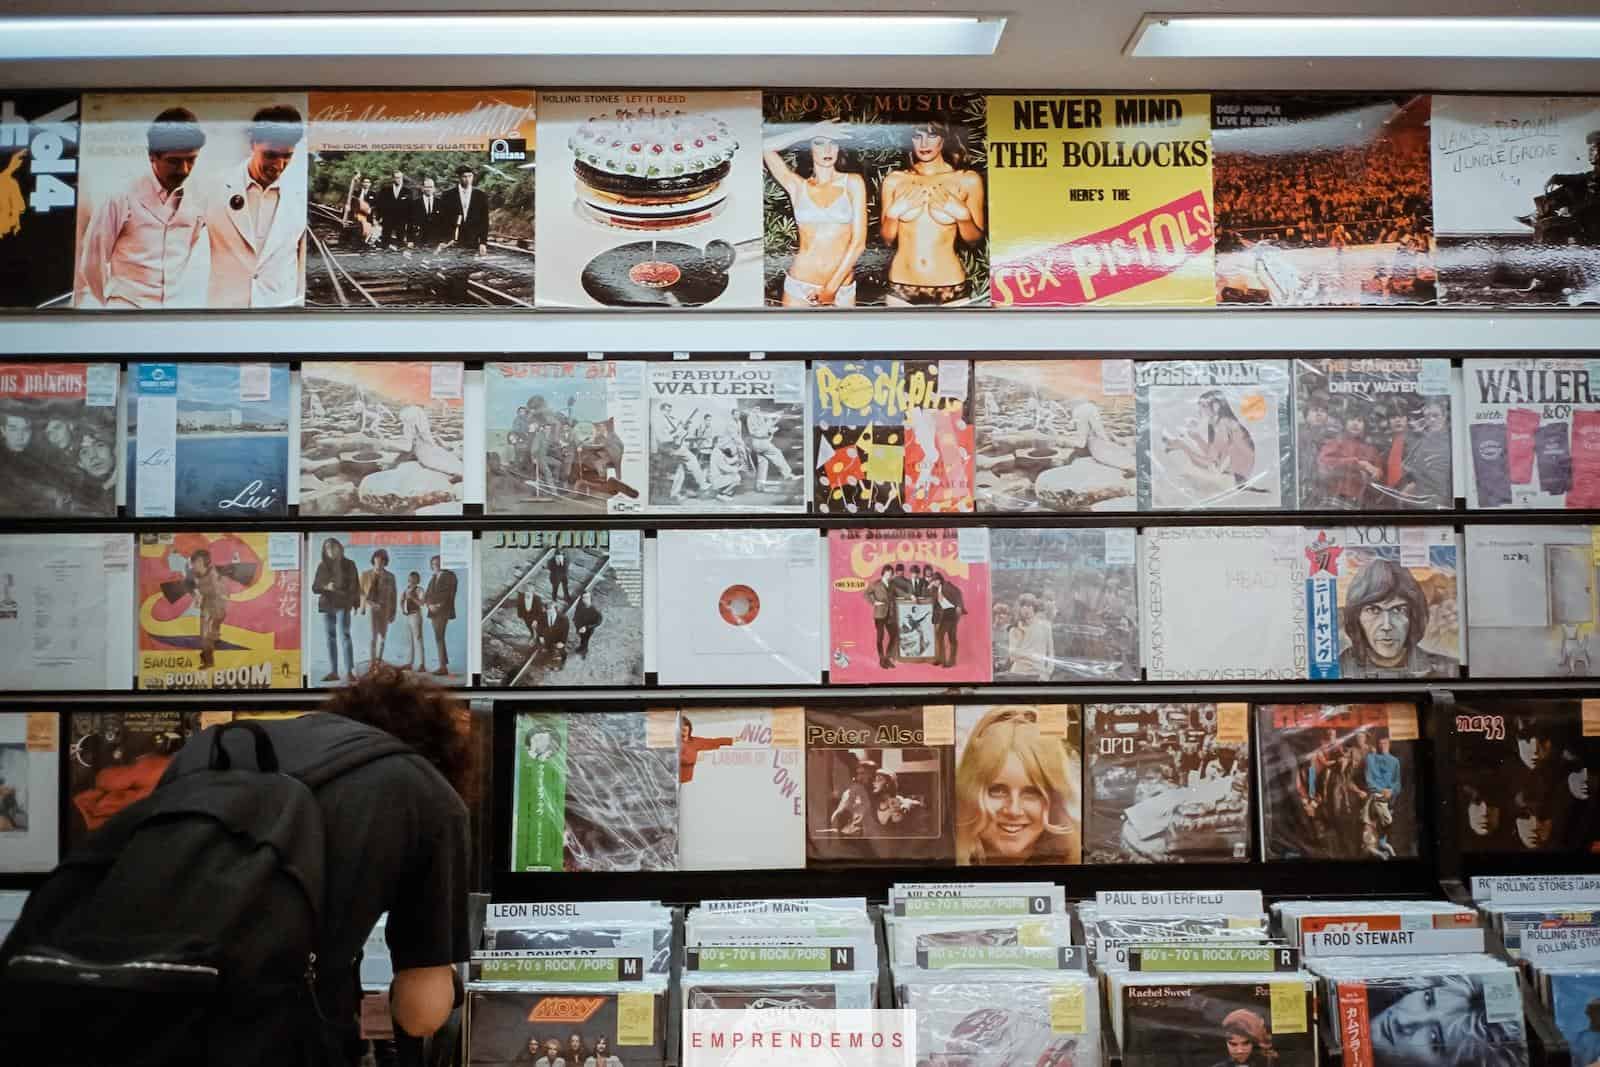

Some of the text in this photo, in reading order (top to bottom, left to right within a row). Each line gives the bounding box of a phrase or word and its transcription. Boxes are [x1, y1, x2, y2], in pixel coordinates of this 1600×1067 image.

[584, 95, 619, 103] STONES
[626, 95, 641, 103] LET
[645, 95, 653, 103] IT
[657, 95, 686, 103] BLEED
[783, 95, 962, 112] ROXY MUSIC
[1013, 98, 1183, 130] NEVER MIND
[990, 140, 1209, 168] THE BOLLOCKS
[1069, 188, 1131, 201] HERE'S THE
[671, 370, 772, 380] FABULOU
[1329, 381, 1370, 393] DIRTY
[1475, 369, 1598, 404] WAILER
[218, 480, 278, 509] Lui
[144, 657, 193, 669] SAKURA
[166, 670, 208, 687] BOOM
[213, 662, 272, 686] BOOM
[740, 723, 772, 744] NIC
[807, 725, 924, 745] Peter Also
[1497, 883, 1536, 892] ROLLING
[1538, 881, 1574, 891] STONES
[1105, 892, 1223, 905] PAUL BUTTERFIELD
[494, 904, 580, 918] LEON RUSSEL
[772, 900, 809, 913] MANN
[1324, 933, 1351, 946] ROD
[1356, 931, 1415, 945] STEWART
[1528, 929, 1600, 940] ROLLING STONE
[1537, 942, 1578, 954] ROLLING
[760, 949, 827, 960] ROCK/POPS
[836, 949, 848, 964] N
[1064, 951, 1074, 962] P
[1117, 951, 1125, 963] Q
[1202, 950, 1271, 961] ROCK/POPS
[1281, 952, 1291, 965] R
[544, 959, 615, 971] ROCK/POPS
[624, 960, 637, 974] M
[1128, 987, 1192, 998] Rachel Sweet
[1346, 1007, 1363, 1067] カムフラー
